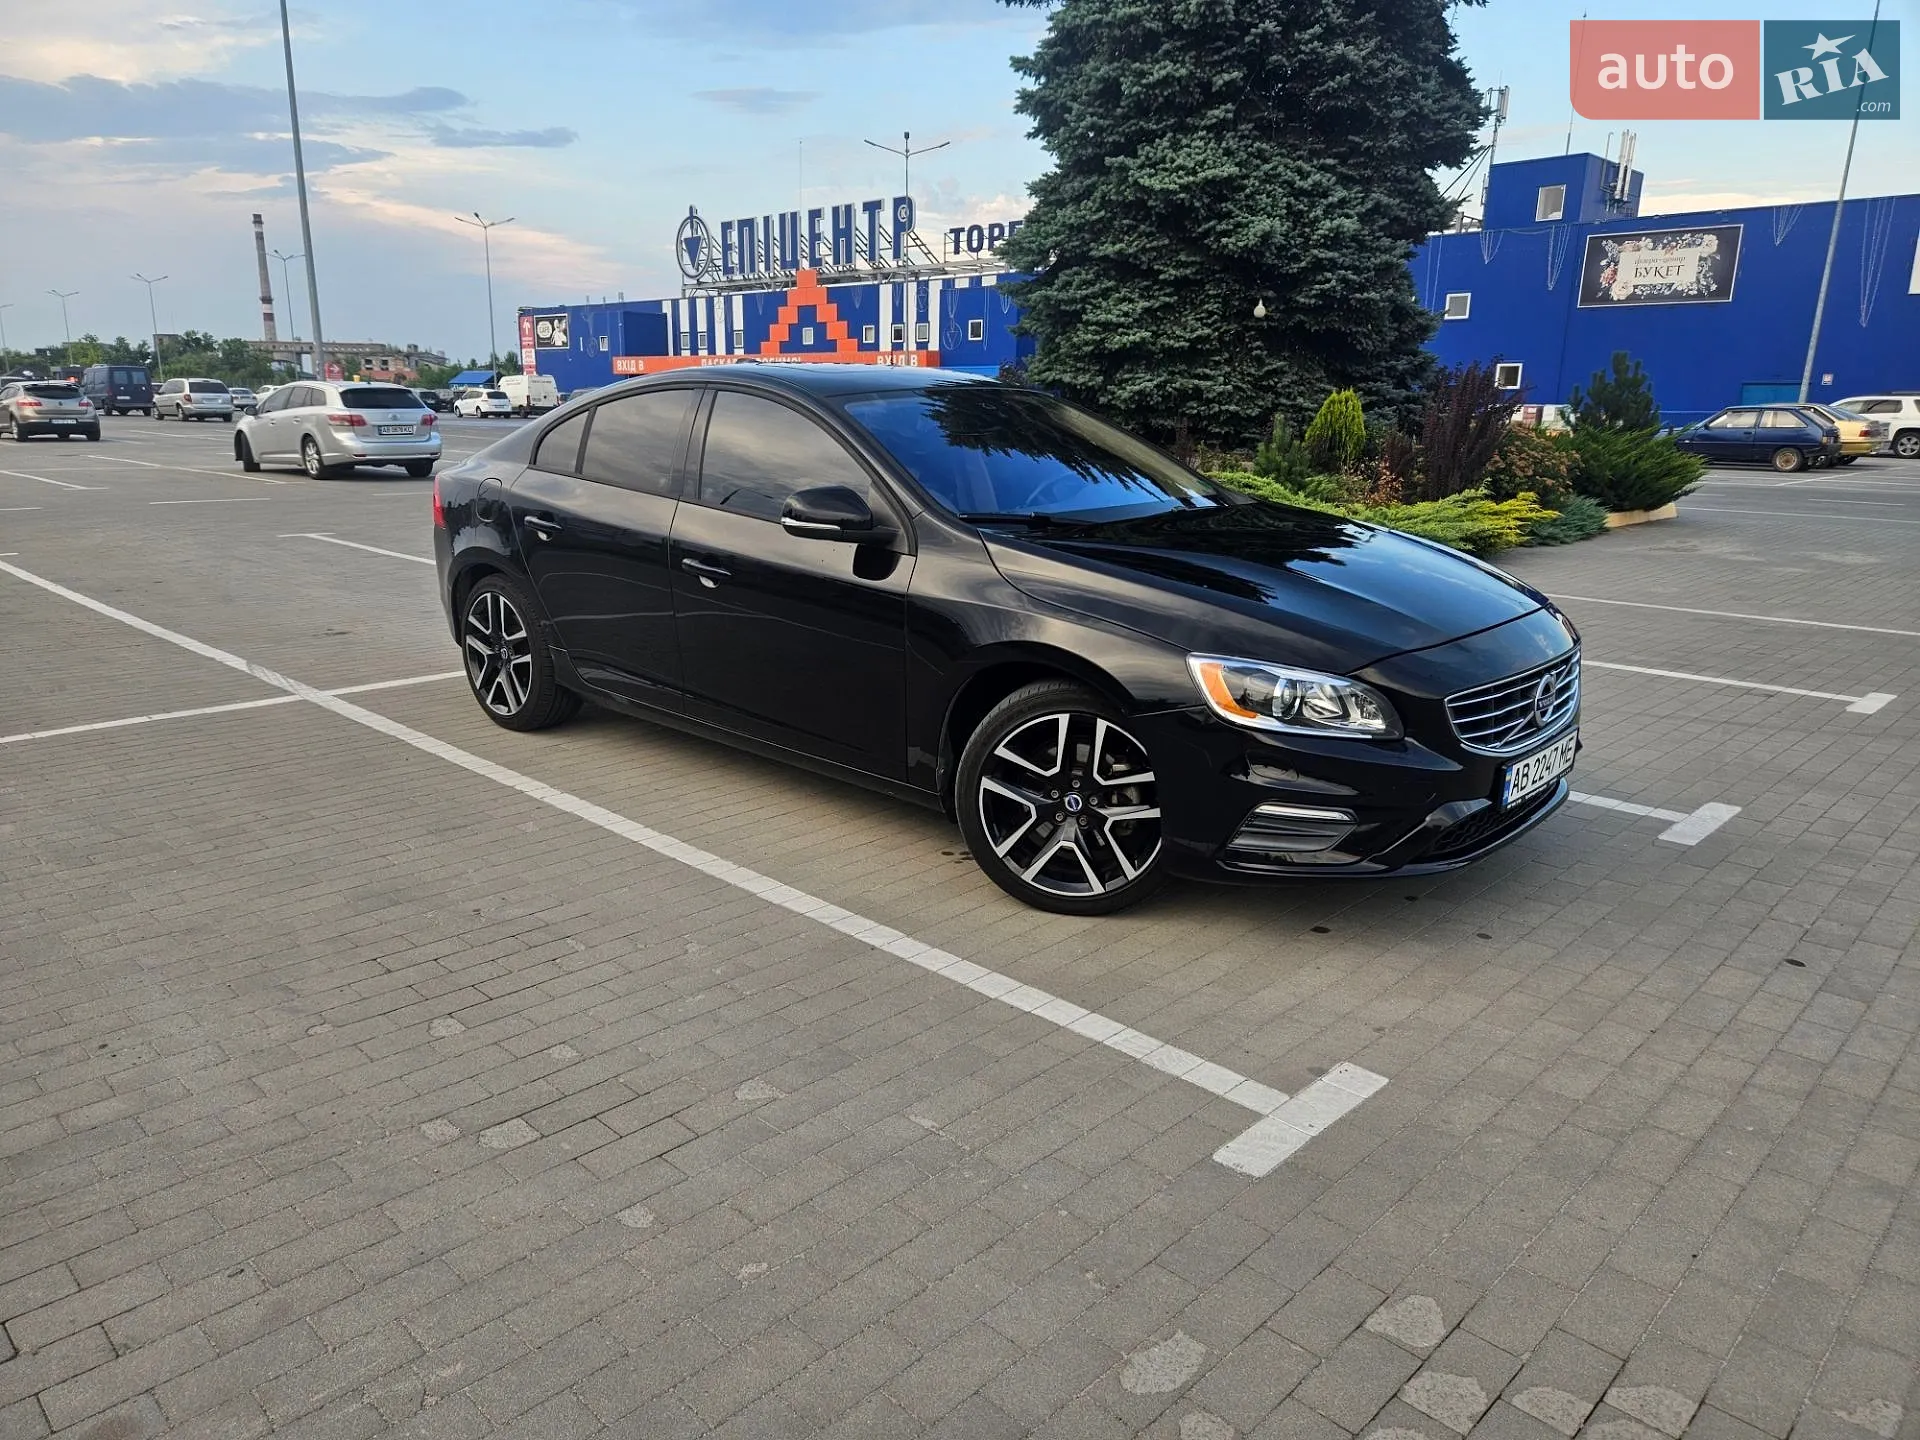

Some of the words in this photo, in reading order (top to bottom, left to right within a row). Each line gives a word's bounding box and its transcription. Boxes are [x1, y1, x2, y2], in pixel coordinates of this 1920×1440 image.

[720, 196, 916, 276] ЕПІЦЕНТР
[1634, 265, 1685, 279] БУКЕТ
[617, 360, 637, 373] ВХІД
[1511, 763, 1530, 796] AB
[1531, 746, 1559, 786] 2247
